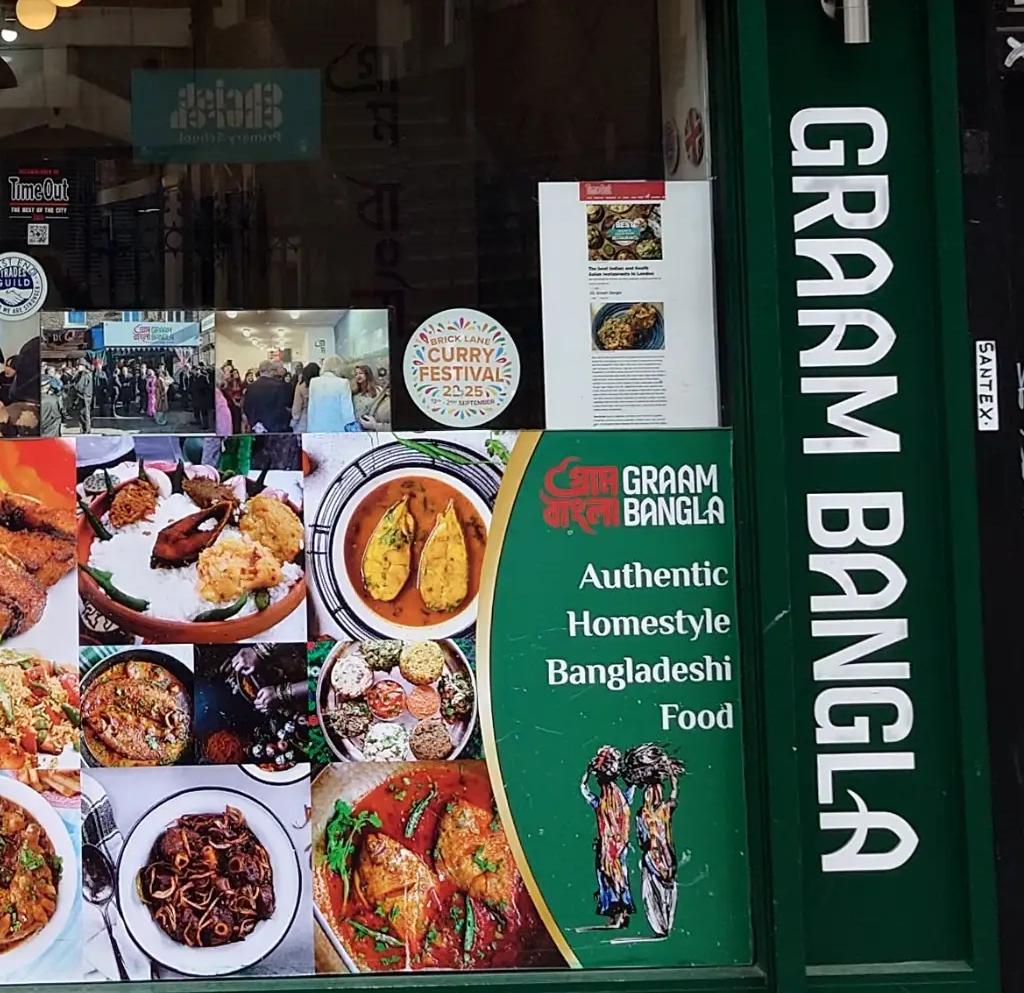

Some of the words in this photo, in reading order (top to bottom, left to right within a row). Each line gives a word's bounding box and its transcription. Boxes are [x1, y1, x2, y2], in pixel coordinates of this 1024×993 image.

[0, 267, 27, 277] TRADES
[789, 106, 901, 455] GRAAM
[427, 347, 495, 363] CURRY
[430, 336, 461, 346] BRICK
[464, 336, 491, 346] LANE
[419, 366, 504, 383] FESTIVAL
[544, 456, 619, 497] গ্রাম
[622, 464, 719, 495] GRAAM
[538, 490, 620, 535] বাংলা
[623, 495, 726, 527] BANGLA
[578, 560, 730, 590] Authentic
[566, 608, 732, 642] Homestyle
[545, 655, 733, 691] Bangladeshi
[806, 491, 920, 873] BANGLA
[659, 702, 735, 731] Food
